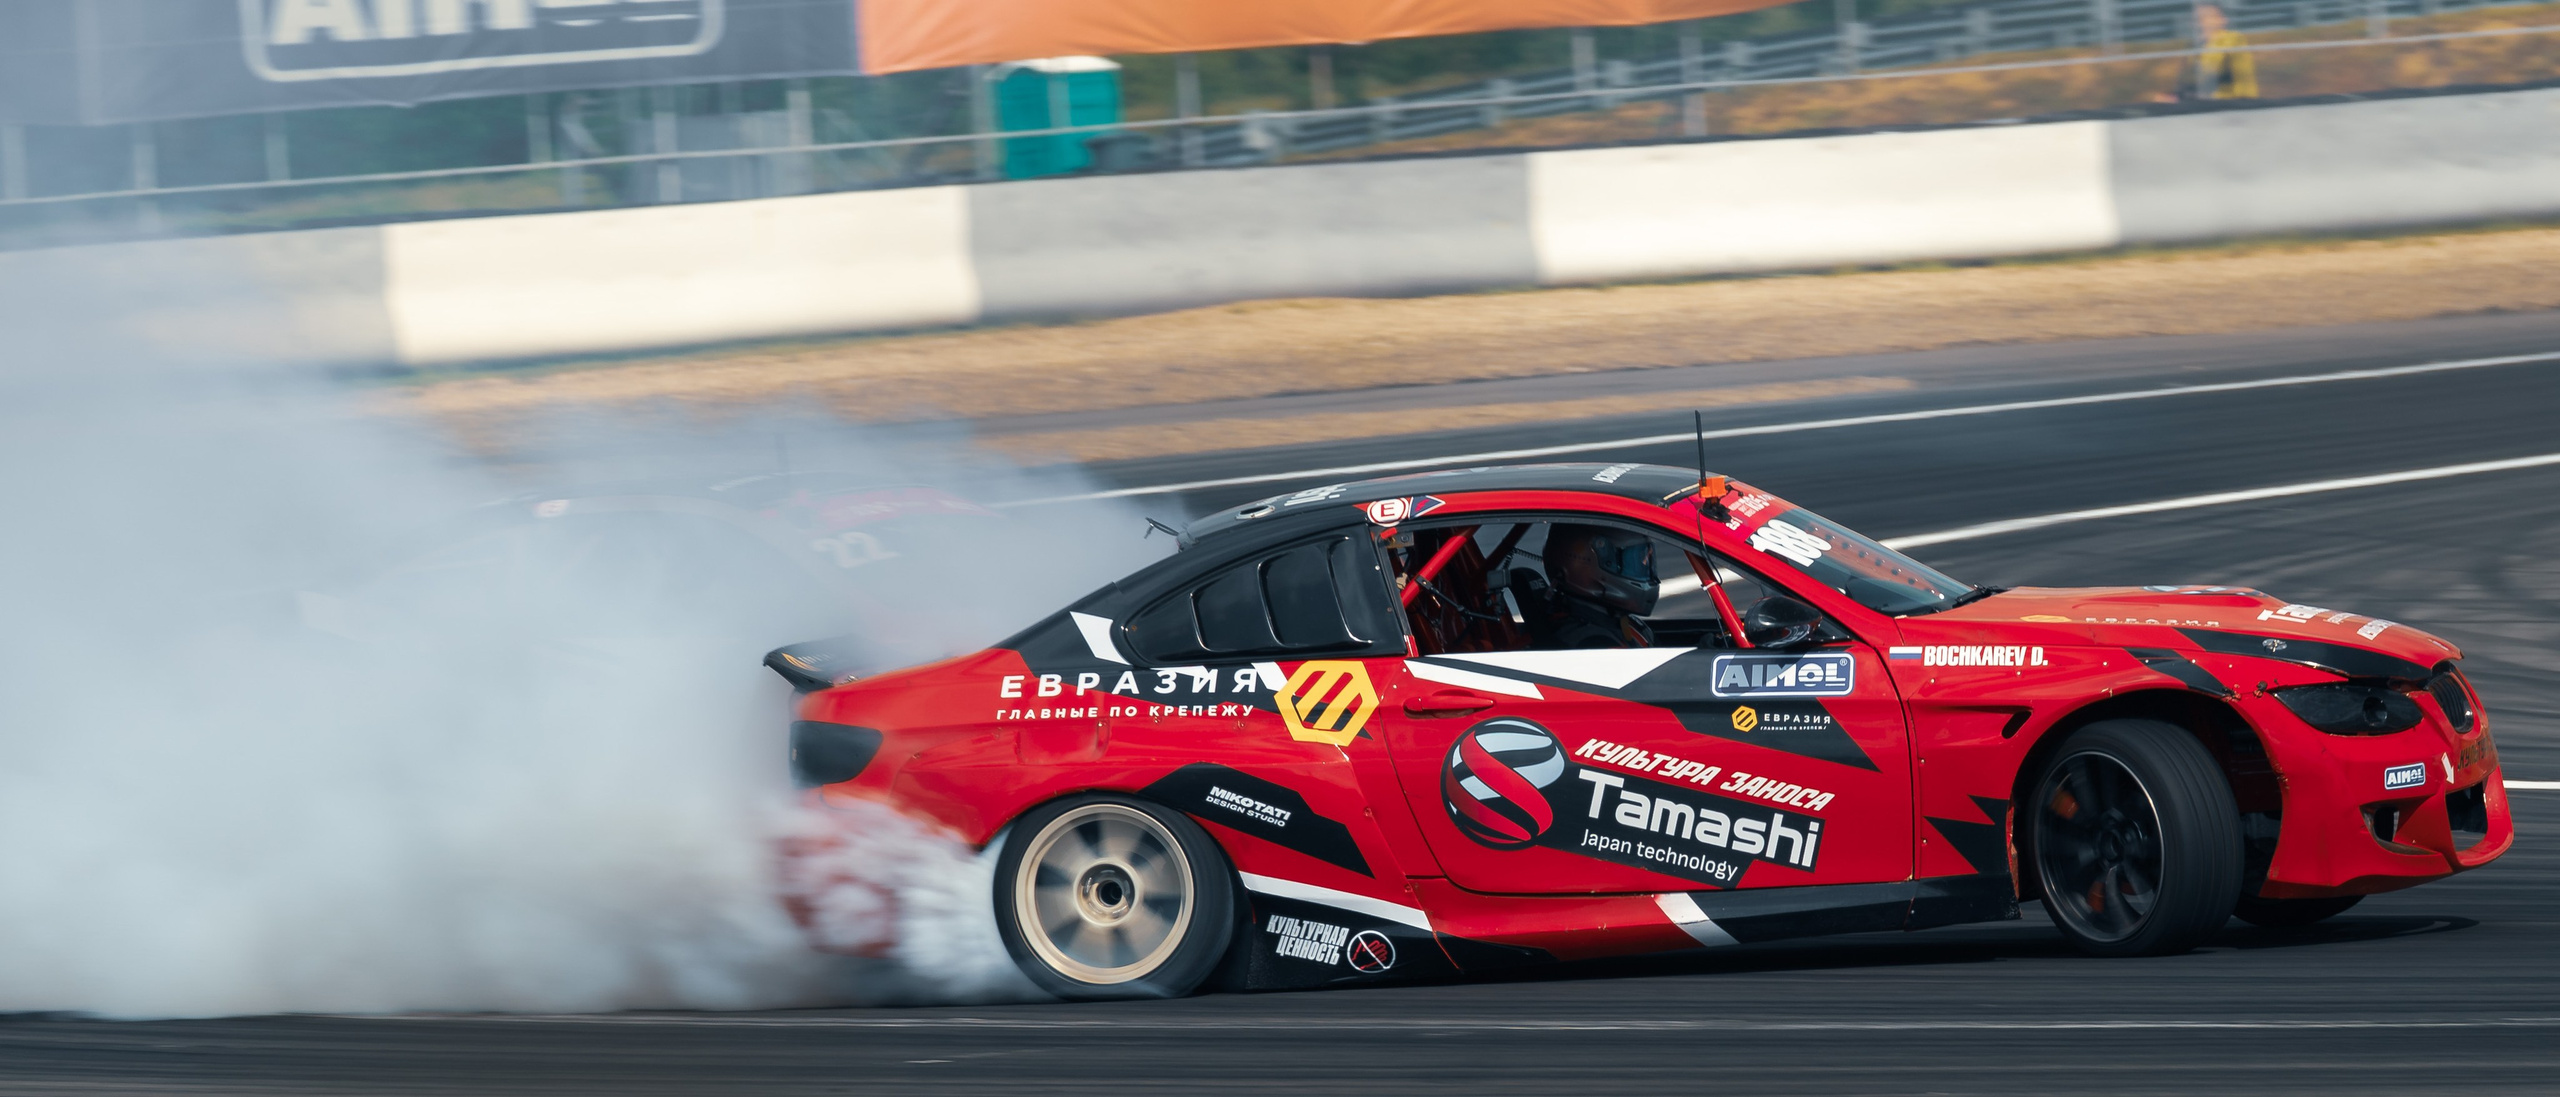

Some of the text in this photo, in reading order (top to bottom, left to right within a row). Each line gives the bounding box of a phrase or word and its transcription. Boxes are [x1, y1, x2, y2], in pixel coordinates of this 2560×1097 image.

[1750, 519, 1832, 567] 188
[1923, 646, 2049, 666] BOCHKAREV D.
[1000, 668, 1258, 699] ЕВРАЗИЯ
[1718, 663, 1846, 687] AIMOL
[996, 704, 1254, 720] ГЛАВНЫЕ ПО КРЕПЕЖУ
[1764, 713, 1831, 724] ЕВРАЗИЯ
[1575, 738, 1835, 811] КУЛЬТУРА ЗАНОСА
[1206, 796, 1286, 827] DESIGN STUDIO
[1210, 786, 1291, 821] MIKOTATI
[1579, 769, 1819, 867] Tamashi
[1580, 828, 1739, 881] Japan technology
[1266, 914, 1350, 947] КУЛЬТУРНАЯ
[1276, 935, 1340, 966] ЦЕННОСТЬ
